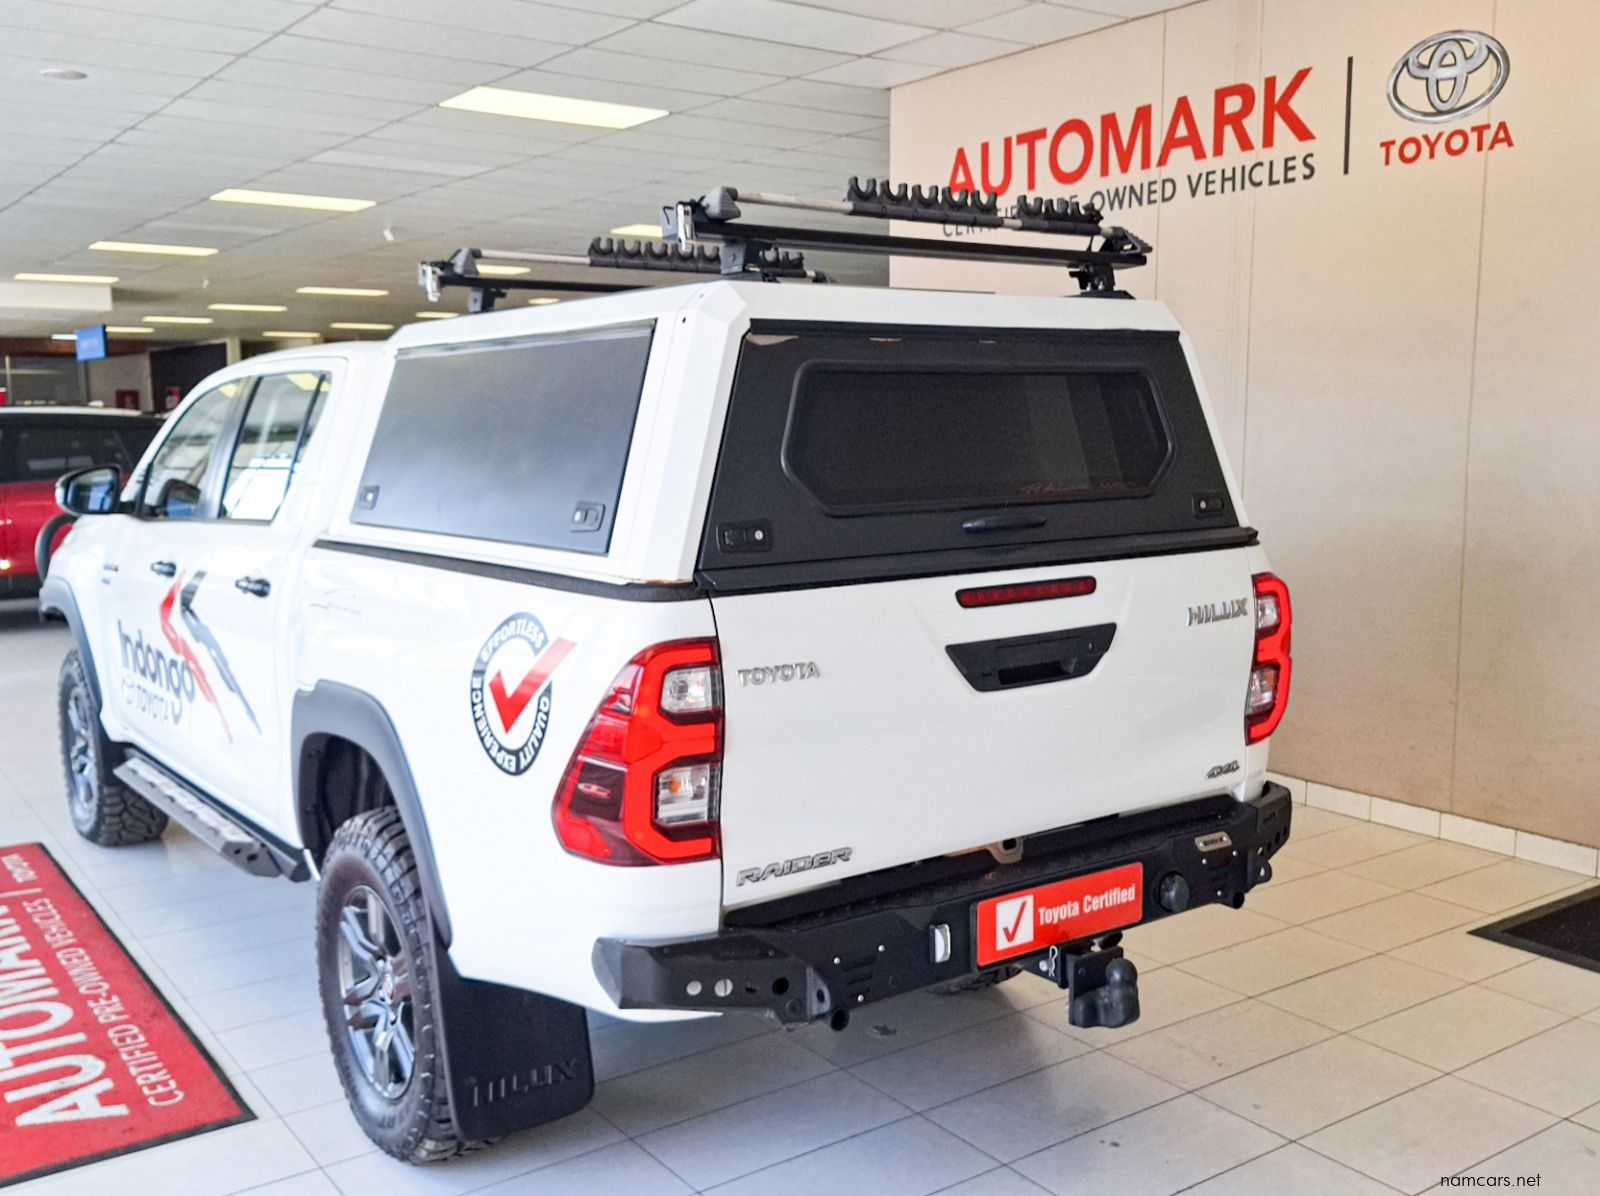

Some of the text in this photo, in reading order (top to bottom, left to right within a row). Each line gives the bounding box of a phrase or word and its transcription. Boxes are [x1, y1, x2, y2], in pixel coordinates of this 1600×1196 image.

[947, 67, 1317, 199] AUTOMARK
[1379, 120, 1514, 166] TOYOTA
[1187, 153, 1316, 199] VEHICLES
[1186, 597, 1248, 627] HILUX
[736, 661, 821, 688] TOYOTA
[518, 695, 551, 770] QUALITY
[736, 846, 853, 888] RAIDER
[1038, 883, 1136, 926] Toyota Certified
[56, 947, 130, 1024] PRE-OWNED
[107, 1023, 185, 1107] CERTIFIED
